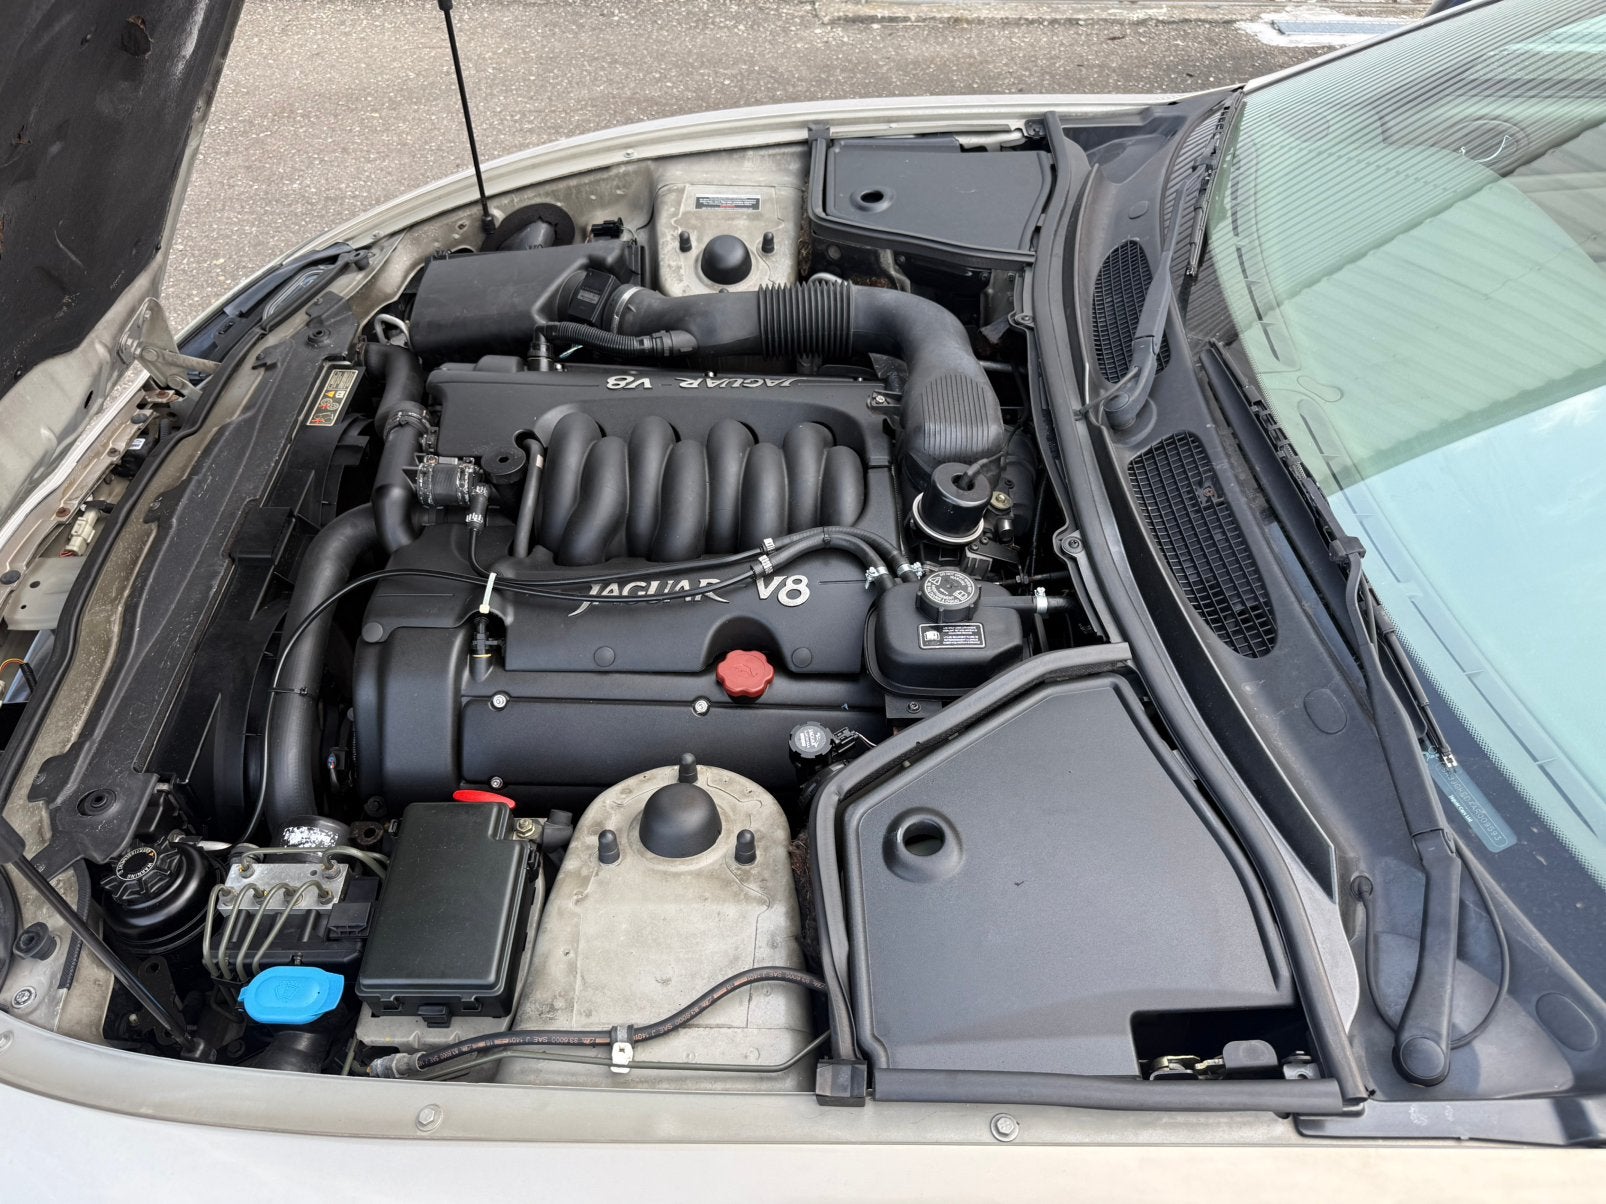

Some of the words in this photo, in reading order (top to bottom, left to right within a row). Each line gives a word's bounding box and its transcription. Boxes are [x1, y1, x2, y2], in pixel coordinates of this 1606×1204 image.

[606, 375, 652, 389] V8
[675, 376, 808, 388] JAGUAR
[568, 579, 730, 617] JAGUAR
[756, 575, 811, 607] V8
